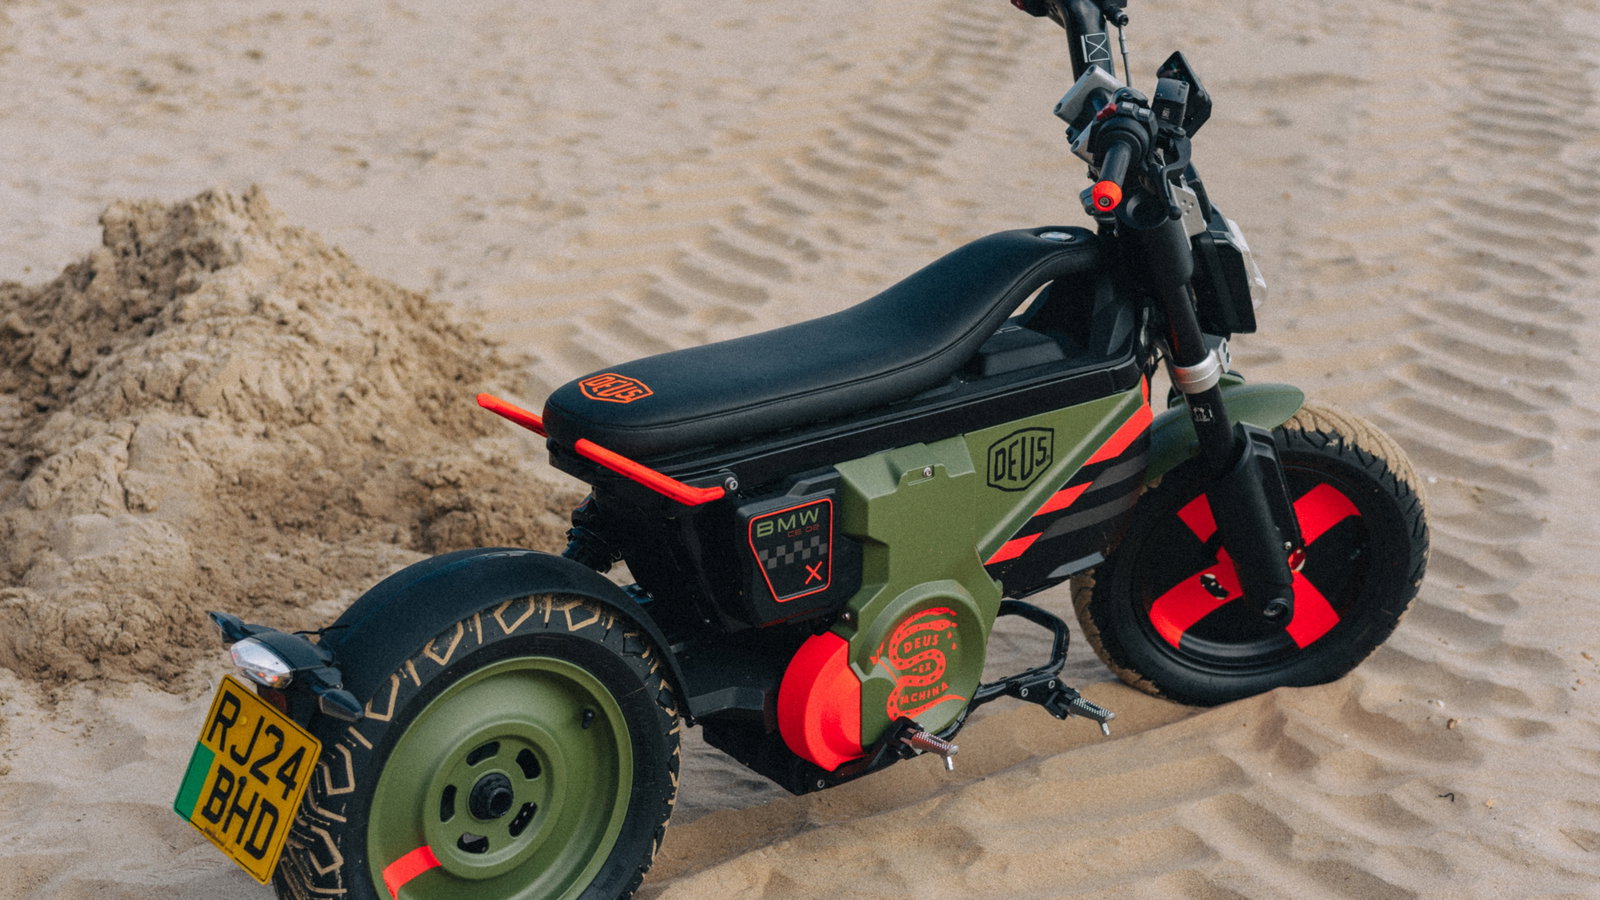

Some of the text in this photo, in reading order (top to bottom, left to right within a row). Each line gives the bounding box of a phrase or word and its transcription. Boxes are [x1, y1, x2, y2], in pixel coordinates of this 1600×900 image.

[584, 375, 644, 400] DEUS
[994, 436, 1047, 482] DEUS
[756, 507, 819, 538] BMW
[805, 560, 823, 585] X
[903, 633, 939, 654] DEUS
[206, 689, 307, 801] RJ24
[201, 763, 280, 861] BHD
